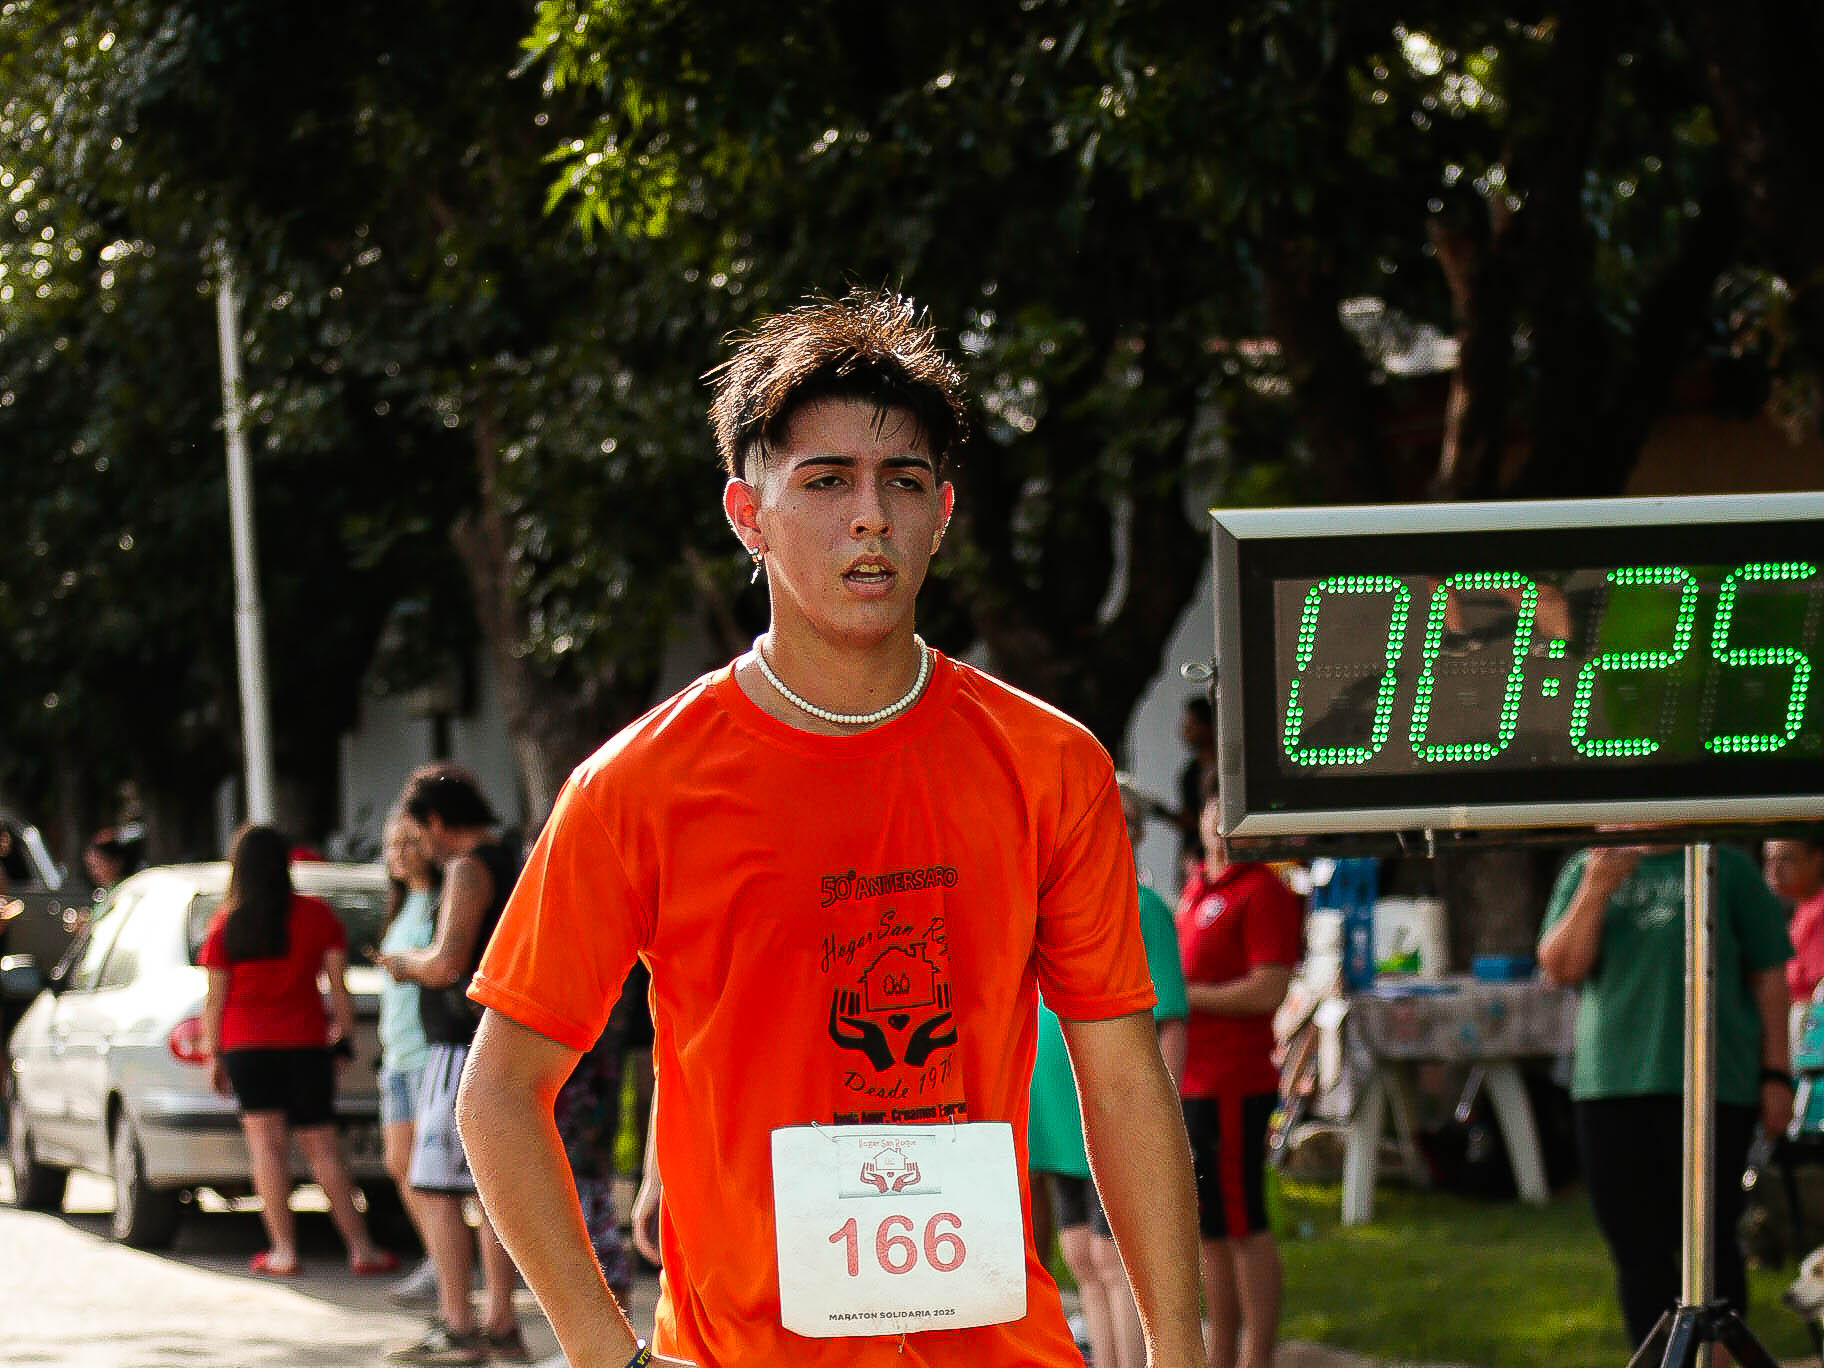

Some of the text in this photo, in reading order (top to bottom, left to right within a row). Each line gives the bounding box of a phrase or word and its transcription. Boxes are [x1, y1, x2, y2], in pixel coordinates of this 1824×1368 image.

[1283, 562, 1816, 767] 00:25
[876, 910, 914, 940] San
[843, 1071, 912, 1100] Desde
[828, 1212, 967, 1277] 166
[828, 1308, 956, 1322] MARATON SOLIDARIA 2025
